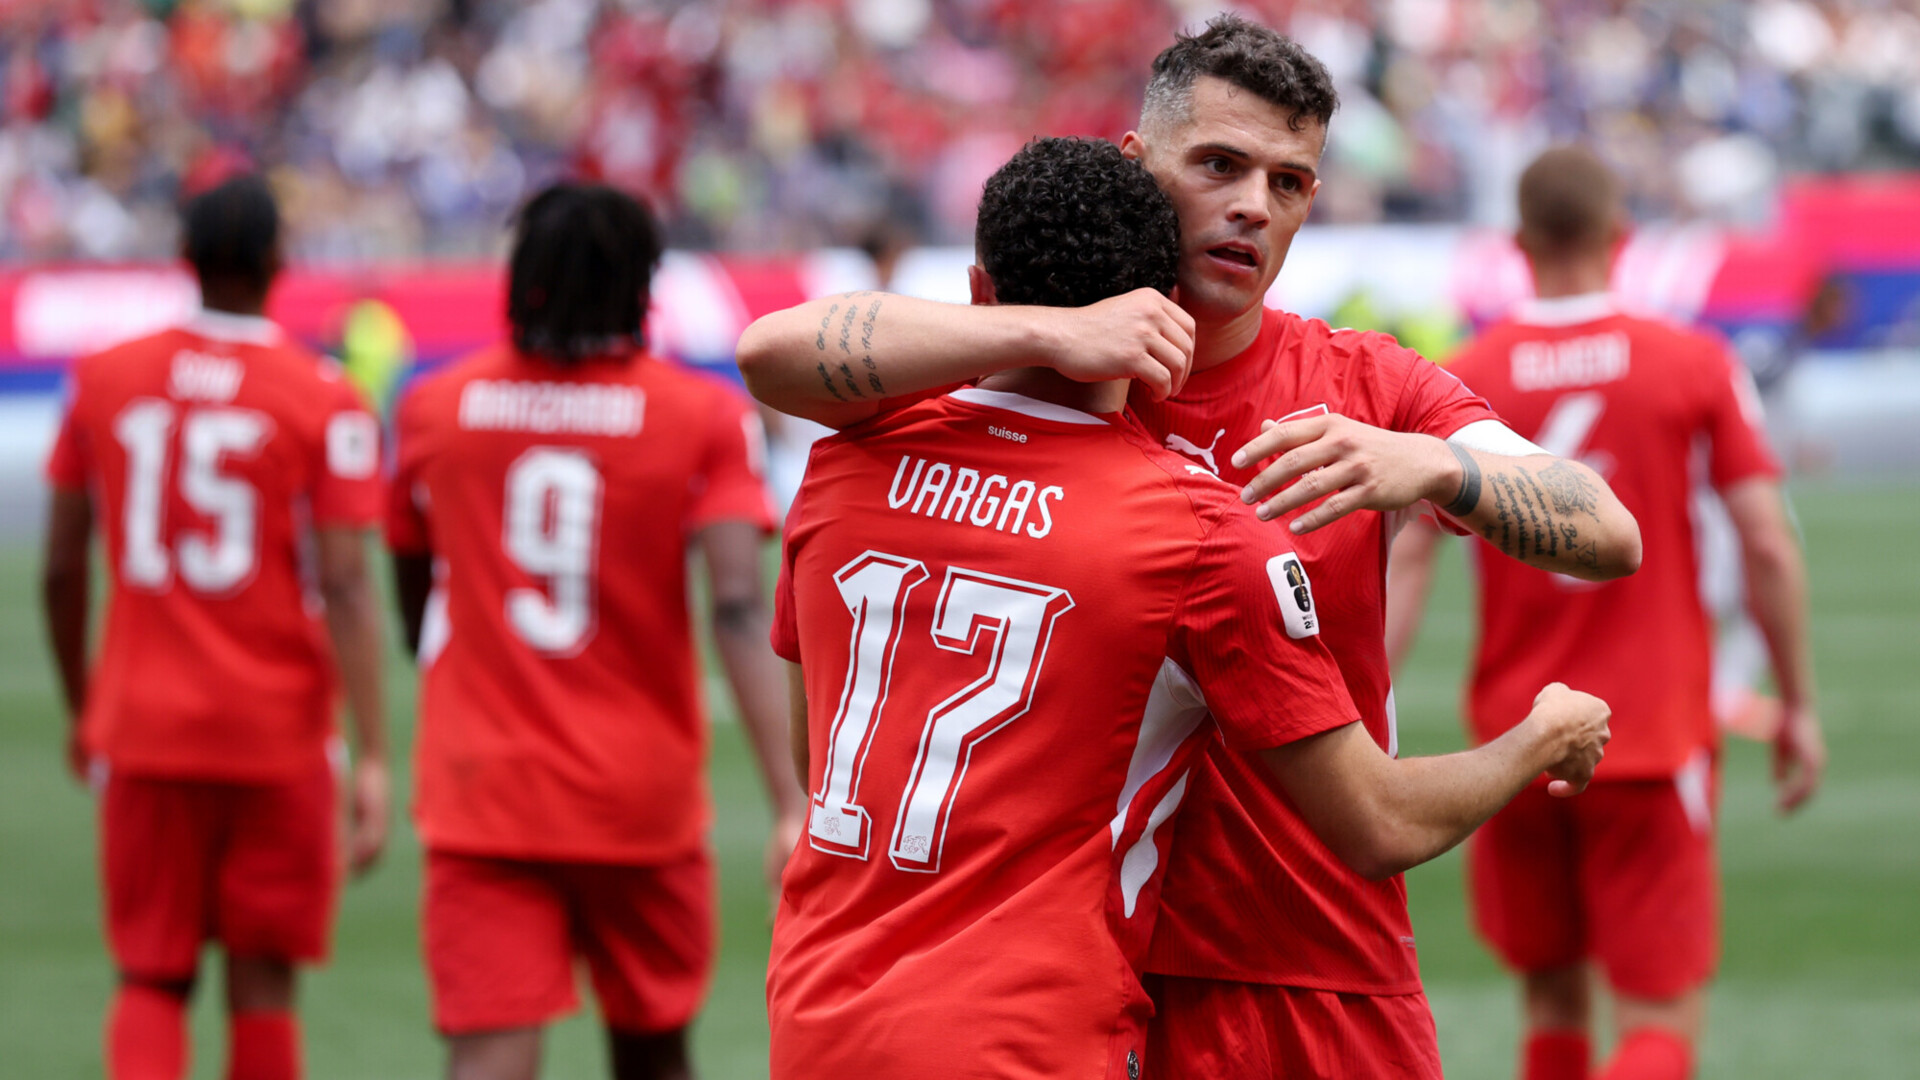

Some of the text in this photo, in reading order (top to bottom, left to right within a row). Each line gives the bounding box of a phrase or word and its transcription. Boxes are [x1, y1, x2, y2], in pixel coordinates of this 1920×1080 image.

[112, 397, 278, 598] 15
[887, 455, 1065, 539] VARGAS
[988, 425, 1028, 444] suisse
[502, 446, 605, 659] 9
[809, 549, 1076, 873] 17
